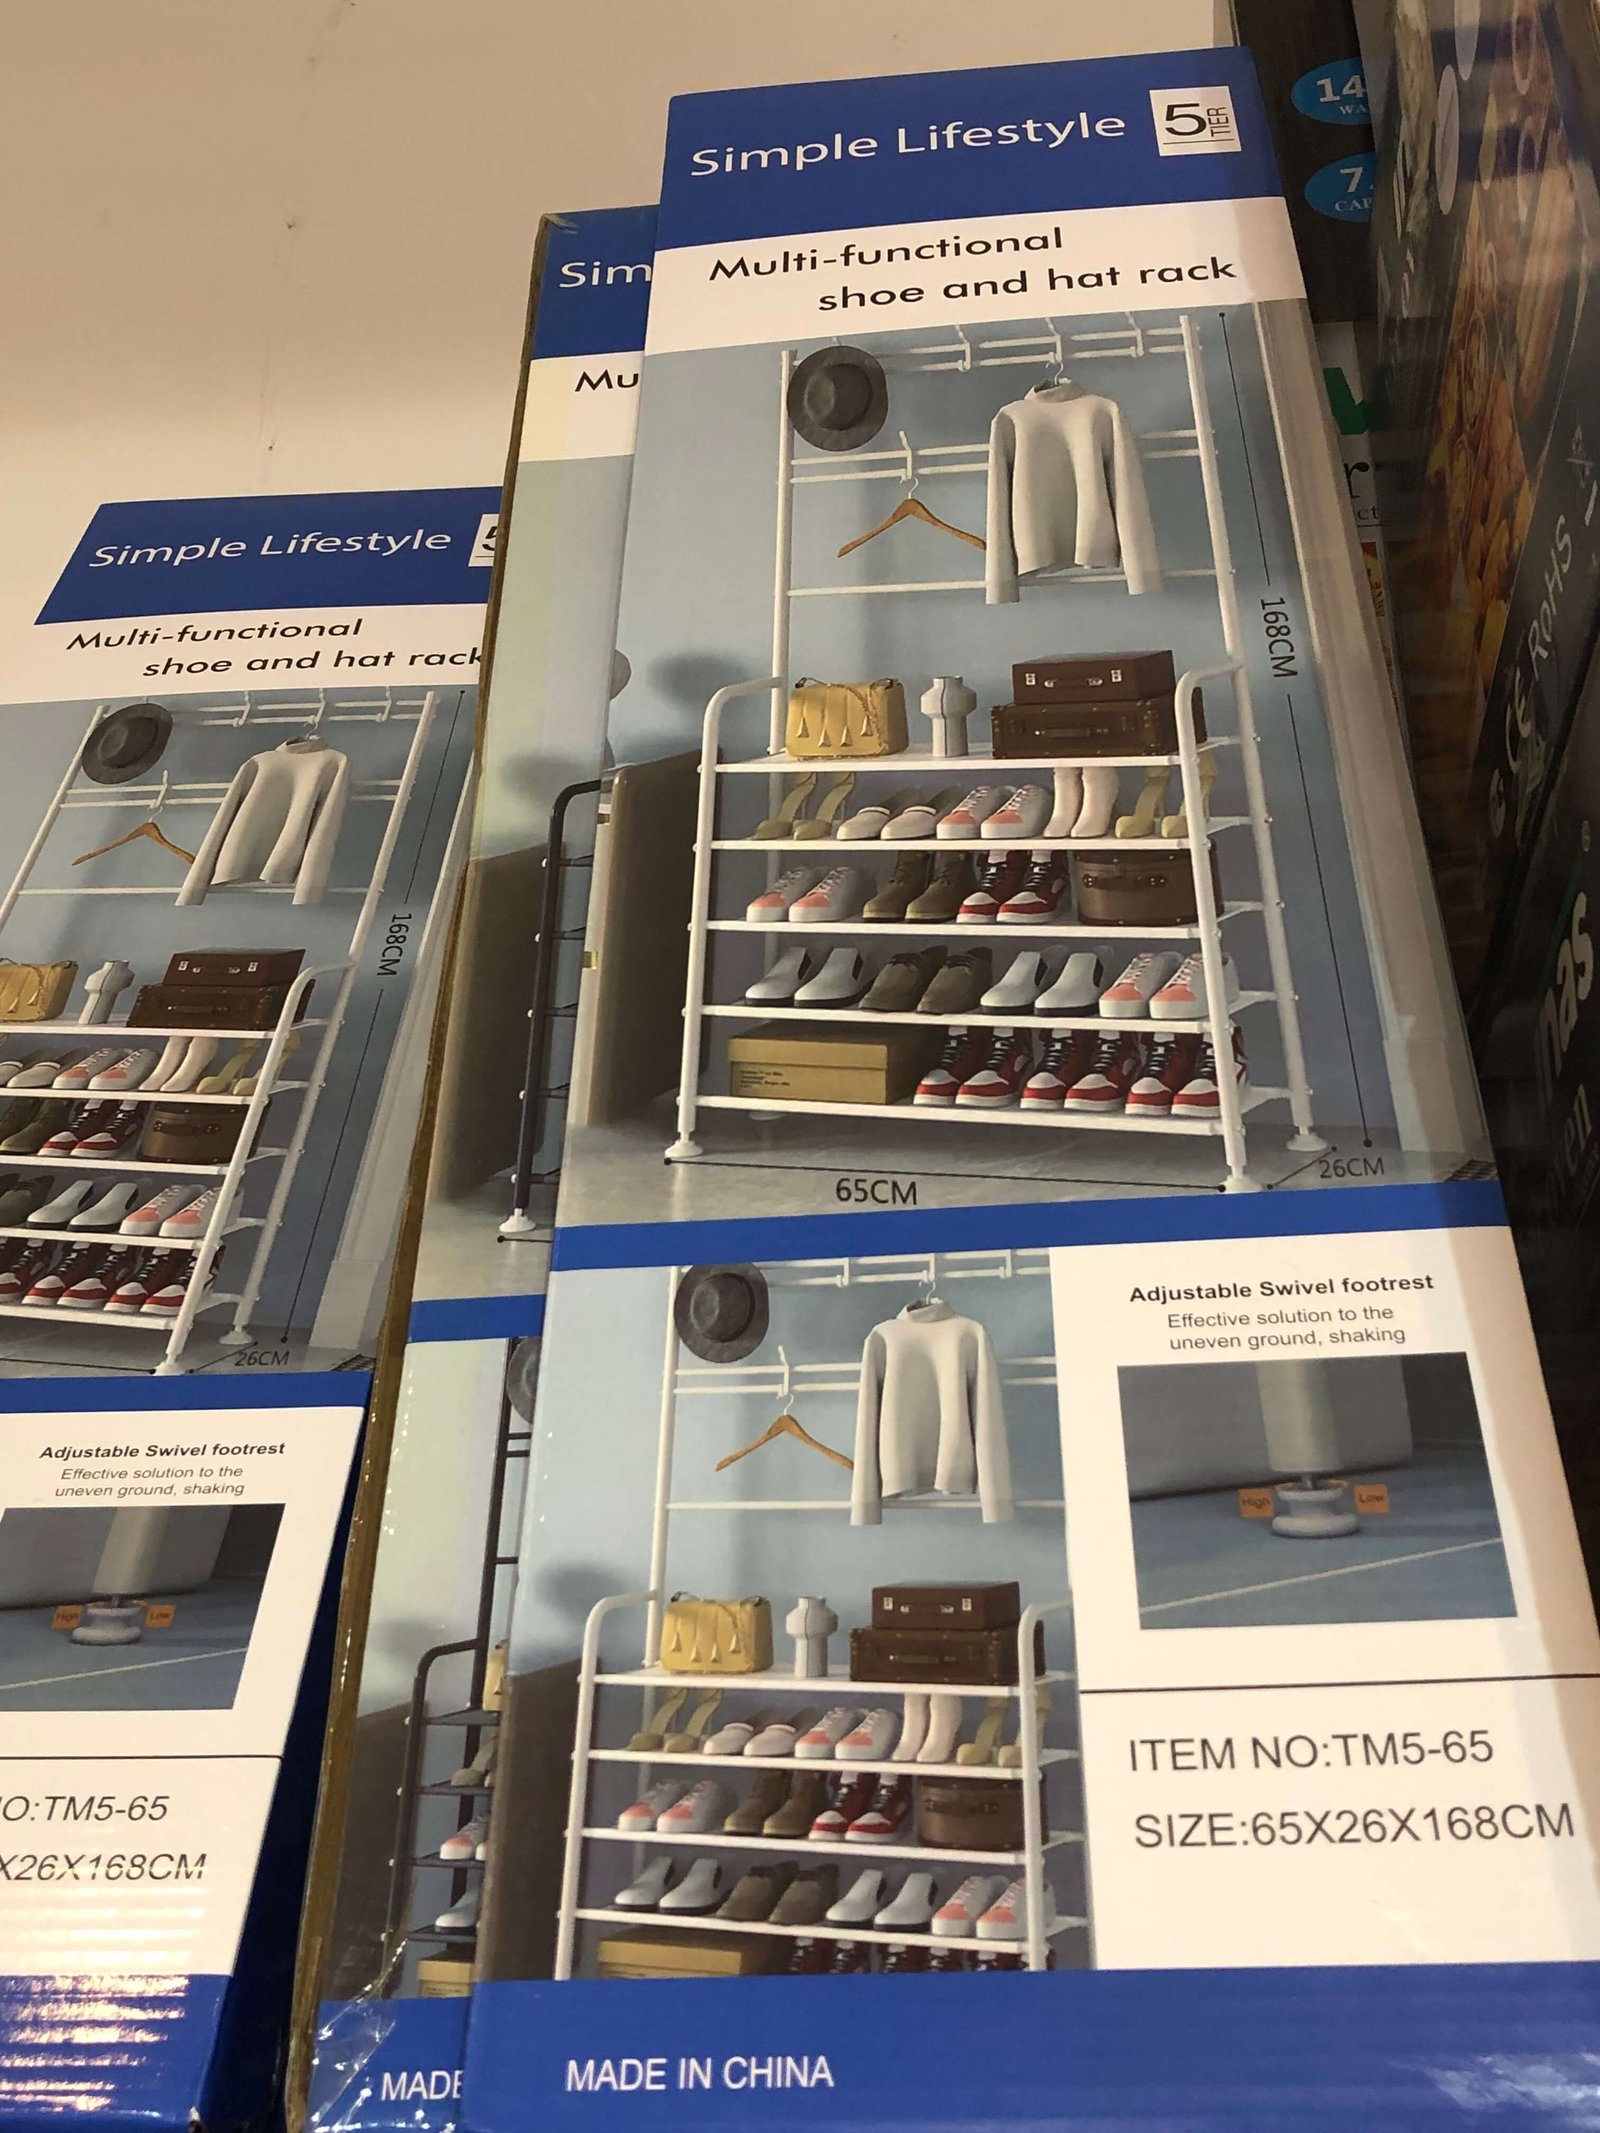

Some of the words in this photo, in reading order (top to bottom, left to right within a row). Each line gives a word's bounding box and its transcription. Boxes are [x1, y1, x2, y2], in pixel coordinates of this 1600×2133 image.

[1165, 103, 1207, 136] 5
[1206, 107, 1232, 138] TIER
[690, 130, 877, 177] Simple
[898, 112, 1126, 155] Lifestyle
[708, 227, 1064, 282] Multi-functional
[818, 284, 925, 312] shoe
[942, 271, 1029, 298] and
[1048, 266, 1121, 291] hat
[1138, 256, 1238, 284] rack
[89, 537, 246, 567] Simple
[260, 529, 451, 557] Lifestyle
[66, 618, 363, 650] Multi-functional
[1260, 597, 1299, 678] 168CM
[142, 656, 232, 677] shoe
[246, 651, 321, 671] and
[334, 649, 396, 669] hat
[408, 646, 483, 667] rack
[376, 913, 413, 977] 168CM
[1318, 1157, 1385, 1179] 26CM
[835, 1178, 918, 1205] 65CM
[1130, 1283, 1252, 1304] Adjustable
[1260, 1279, 1335, 1297] Swivel
[1342, 1274, 1435, 1293] footrest
[1167, 1311, 1250, 1329] Effective
[1257, 1309, 1332, 1325] solution
[1338, 1307, 1358, 1321] to
[1363, 1305, 1394, 1320] the
[1169, 1336, 1242, 1350] uneven
[1247, 1330, 1323, 1351] ground,
[1329, 1326, 1406, 1346] shaking
[234, 1351, 290, 1367] 26CM
[39, 1445, 140, 1461] Adjustable
[145, 1444, 208, 1457] Swivel
[212, 1442, 286, 1456] footrest
[61, 1468, 128, 1480] Effective
[133, 1467, 194, 1479] solution
[199, 1467, 214, 1478] to
[218, 1466, 243, 1478] the
[55, 1485, 113, 1497] uneven
[117, 1484, 177, 1499] ground,
[183, 1483, 245, 1497] shaking
[1130, 1737, 1236, 1772] ITEM
[1252, 1729, 1494, 1769] NO:TM5-65
[0, 1795, 170, 1821] O:TM5-65
[1134, 1803, 1575, 1848] SIZE:65X26X168CM
[565, 2057, 667, 2091] MADE
[679, 2057, 711, 2090] IN
[723, 2055, 834, 2089] CHINA
